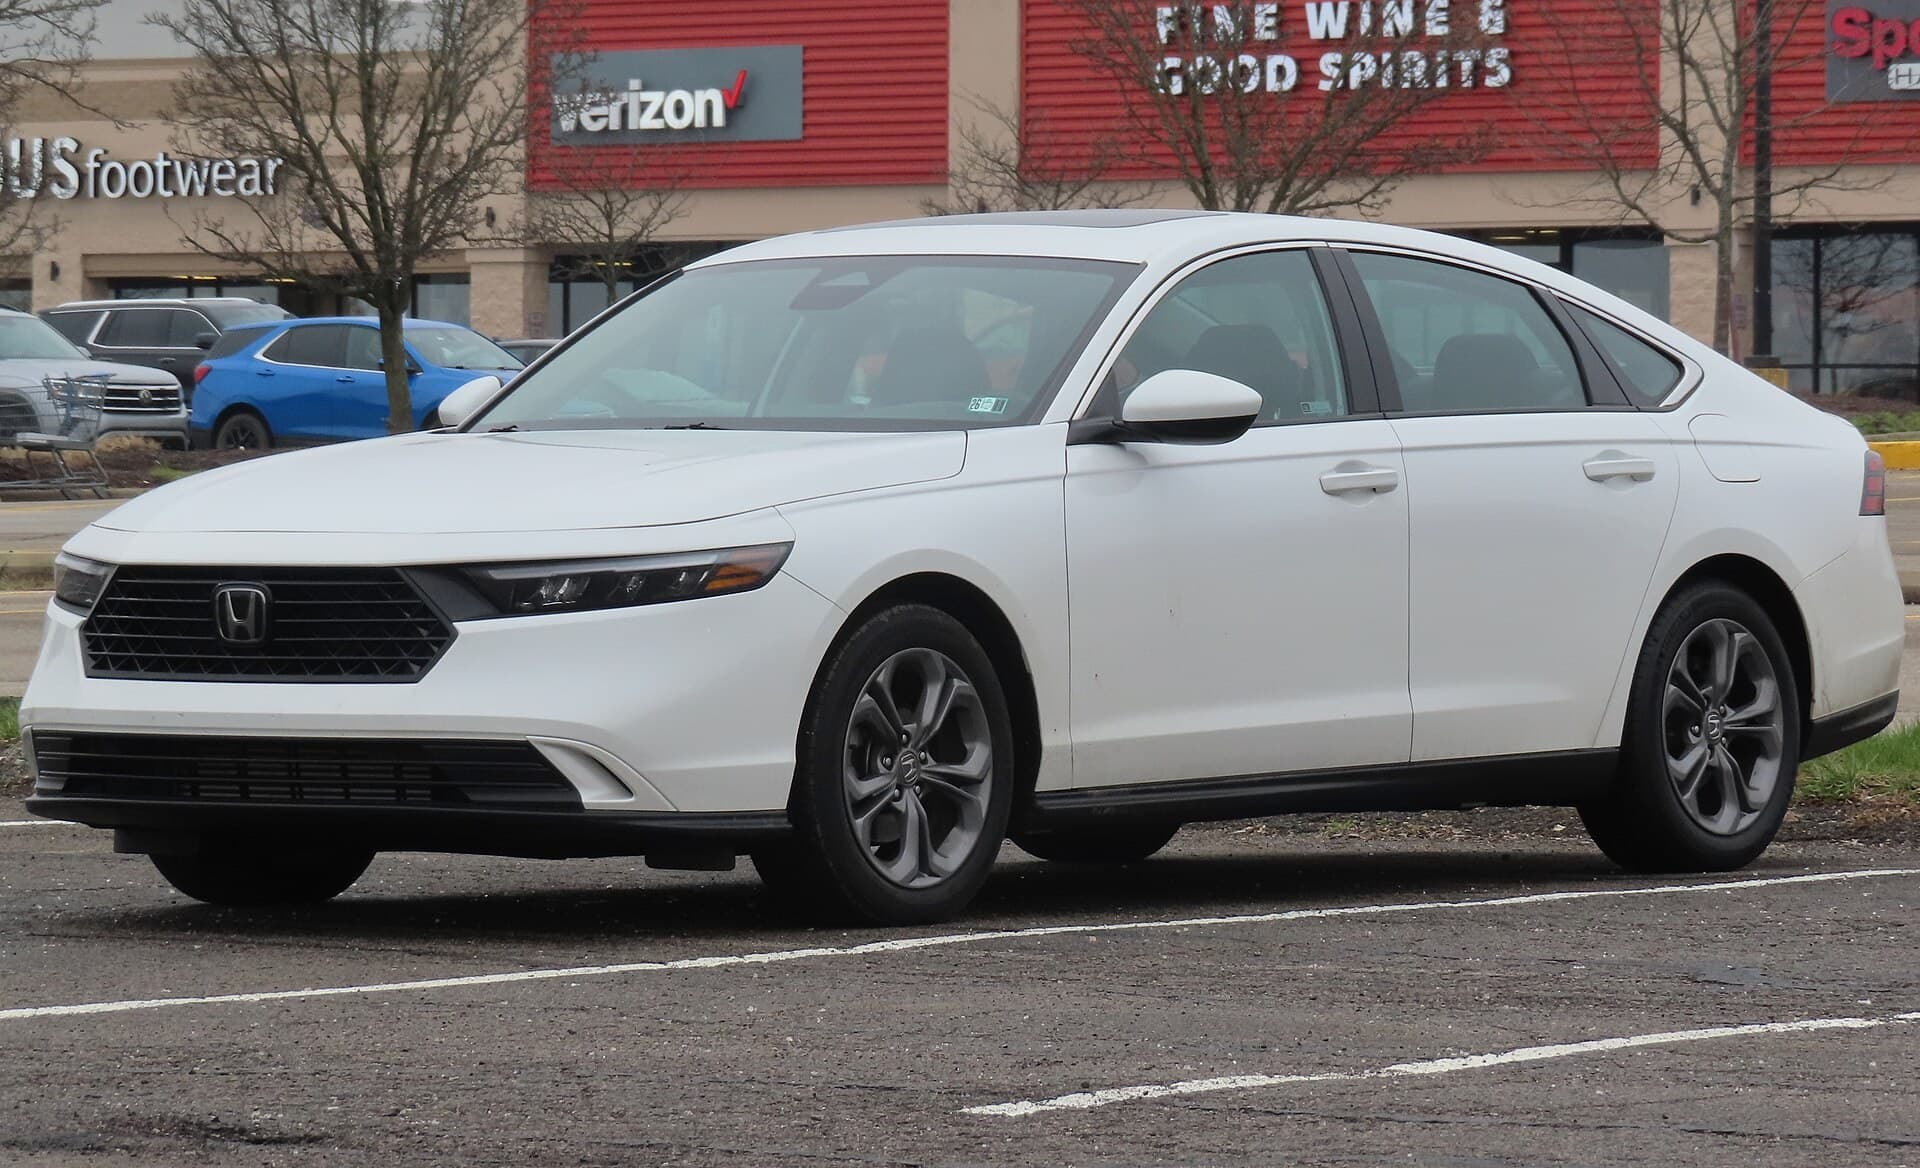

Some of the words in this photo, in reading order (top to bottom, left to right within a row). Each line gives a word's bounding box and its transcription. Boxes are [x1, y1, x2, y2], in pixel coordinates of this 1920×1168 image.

[1305, 0, 1450, 40] WINE
[1154, 54, 1298, 95] GOOD
[1318, 48, 1512, 91] SPIRITS
[1894, 66, 1920, 86] H
[553, 78, 727, 132] verizon
[0, 136, 80, 200] US
[84, 148, 285, 199] footwear
